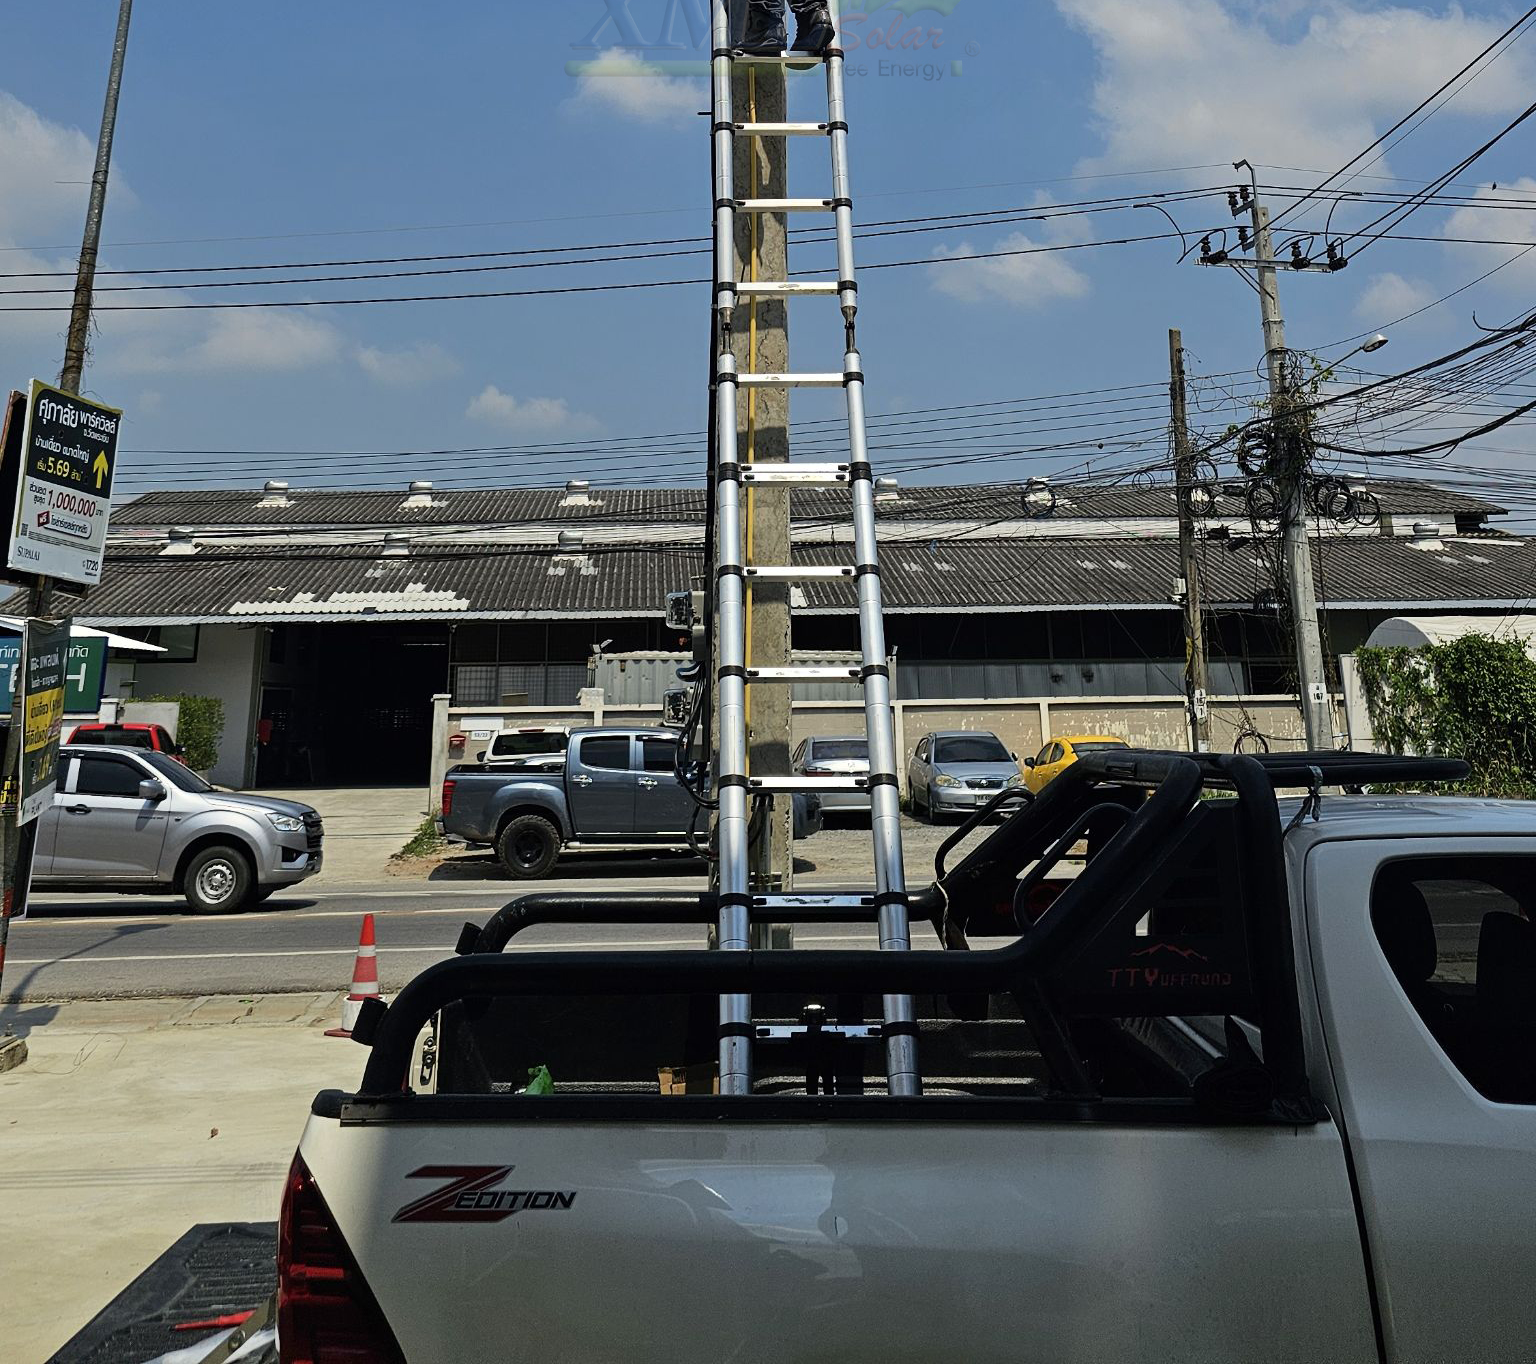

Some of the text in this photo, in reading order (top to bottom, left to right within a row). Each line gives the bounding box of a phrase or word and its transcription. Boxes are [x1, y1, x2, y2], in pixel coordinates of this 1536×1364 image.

[39, 399, 79, 428] ศุภาลัย
[35, 435, 62, 453] บ้านเดี่ยว
[47, 456, 70, 478] 5.69
[48, 489, 96, 518] 1,000,000
[17, 545, 41, 561] SUPALAI
[86, 559, 99, 572] 1720
[455, 1191, 577, 1210] EDITION
